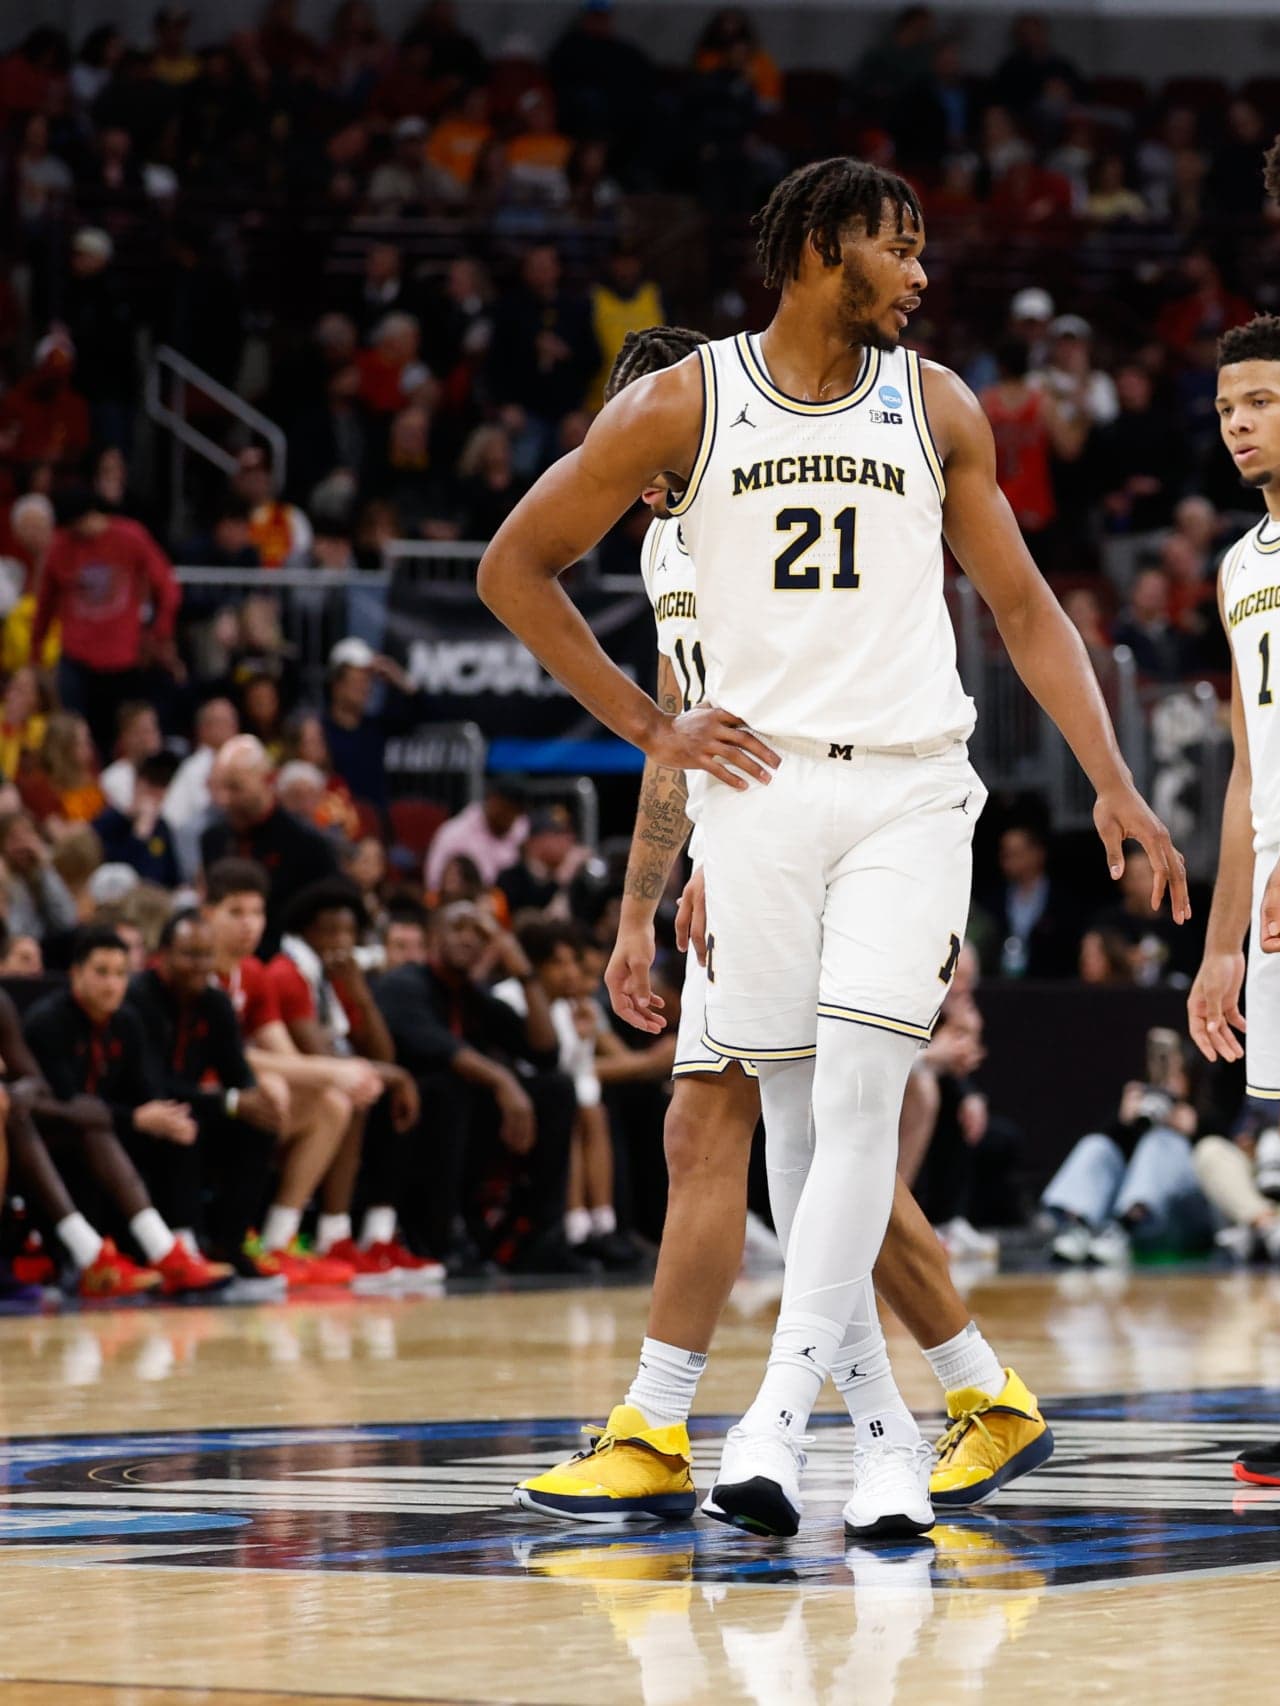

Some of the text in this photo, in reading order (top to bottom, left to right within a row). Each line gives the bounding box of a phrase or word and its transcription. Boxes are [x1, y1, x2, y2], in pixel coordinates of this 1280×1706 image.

[731, 454, 906, 497] MICHIGAN
[773, 504, 862, 592] 21
[1257, 630, 1274, 706] 1
[827, 742, 855, 761] M
